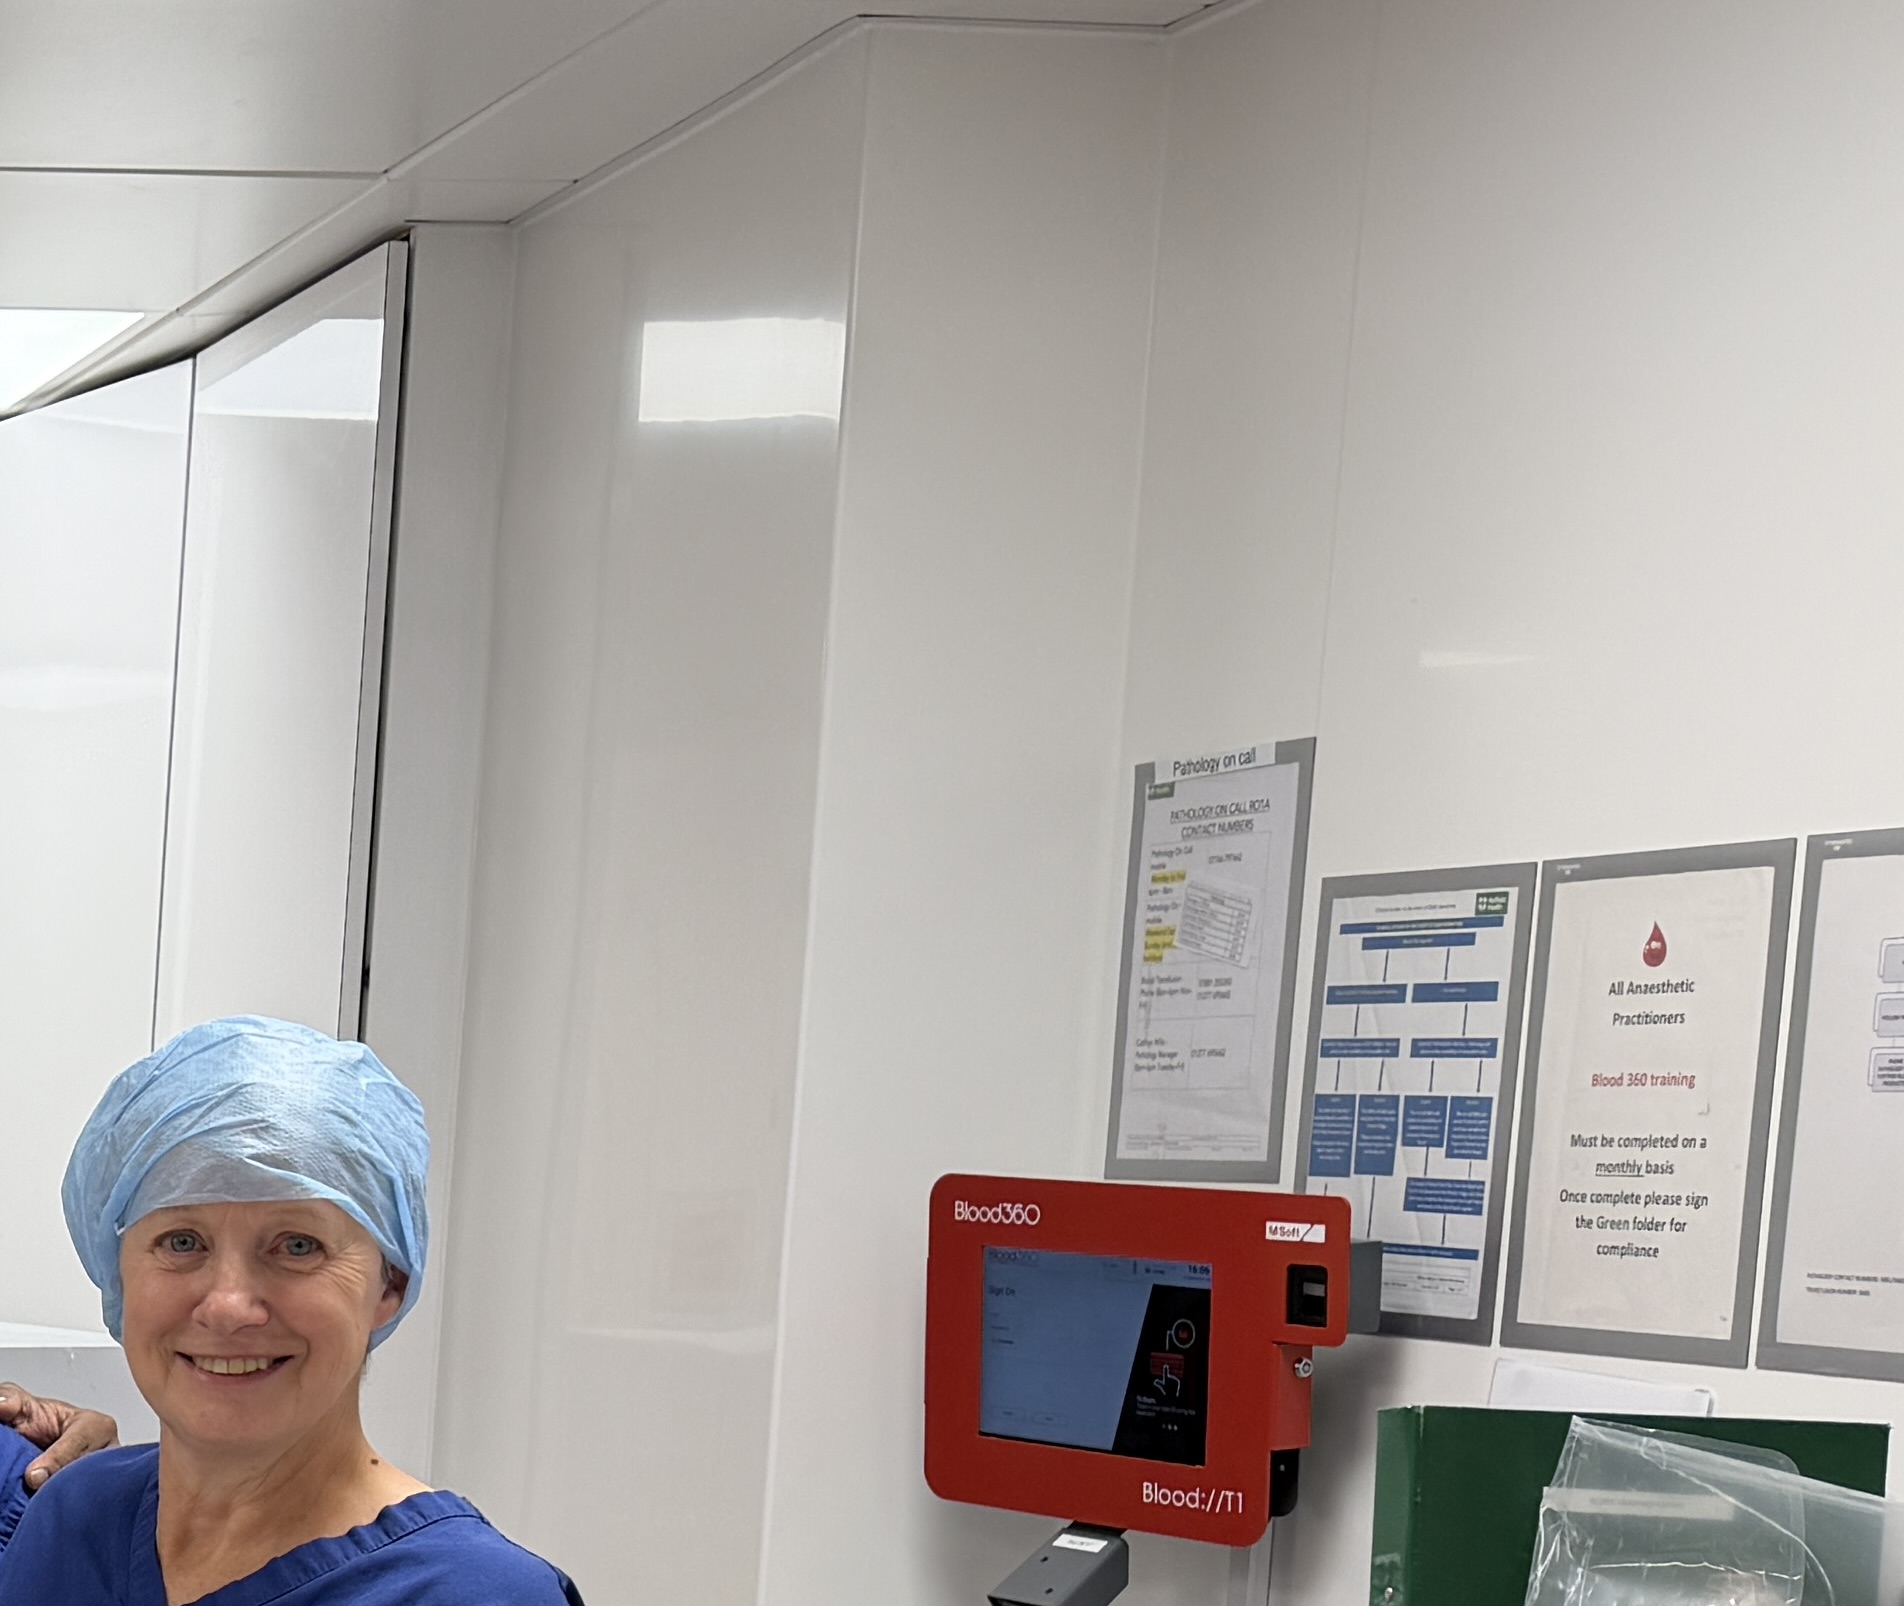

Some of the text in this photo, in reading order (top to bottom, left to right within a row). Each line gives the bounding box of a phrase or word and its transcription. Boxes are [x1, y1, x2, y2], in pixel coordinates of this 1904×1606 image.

[1173, 747, 1256, 777] Pathology on call
[1608, 978, 1695, 996] All Anaesthetic
[1612, 1010, 1686, 1026] Practitioners
[1591, 1071, 1696, 1090] Blood 360 training
[1570, 1133, 1708, 1151] Must be completed on a
[1595, 1159, 1675, 1178] monthly basis
[1559, 1188, 1709, 1210] Once complete please sign
[954, 1200, 1041, 1226] Blood360
[1575, 1215, 1688, 1232] the Green folder for
[1596, 1242, 1660, 1259] compliance
[1142, 1481, 1243, 1514] Blood://T1
